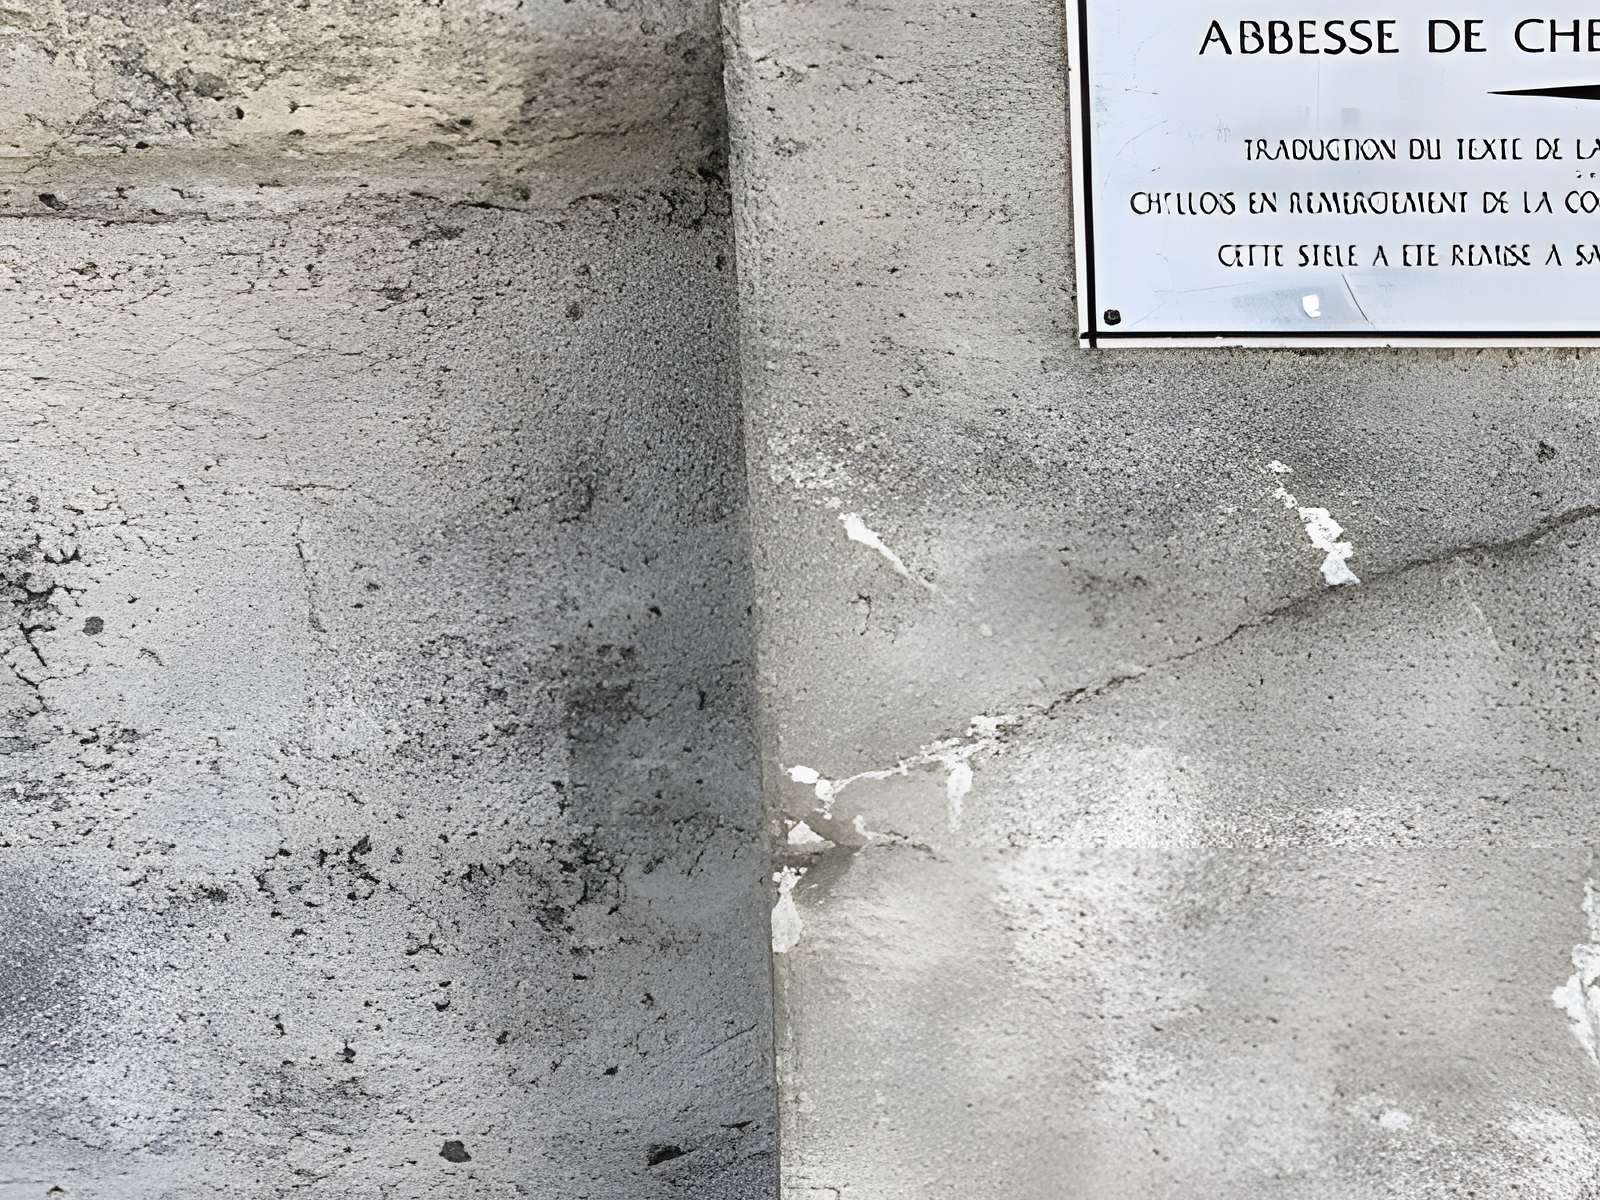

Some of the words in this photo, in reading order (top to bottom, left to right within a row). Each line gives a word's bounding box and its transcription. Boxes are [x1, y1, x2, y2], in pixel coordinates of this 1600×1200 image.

[1198, 19, 1400, 56] ABBESSE
[1428, 19, 1487, 54] DE
[1244, 138, 1396, 162] TRADUCTION
[1409, 138, 1441, 160] DU
[1456, 137, 1523, 161] TEXTE
[1536, 137, 1563, 160] DE
[1248, 191, 1277, 215] EN
[1482, 191, 1509, 214] DE
[1523, 191, 1553, 214] LA
